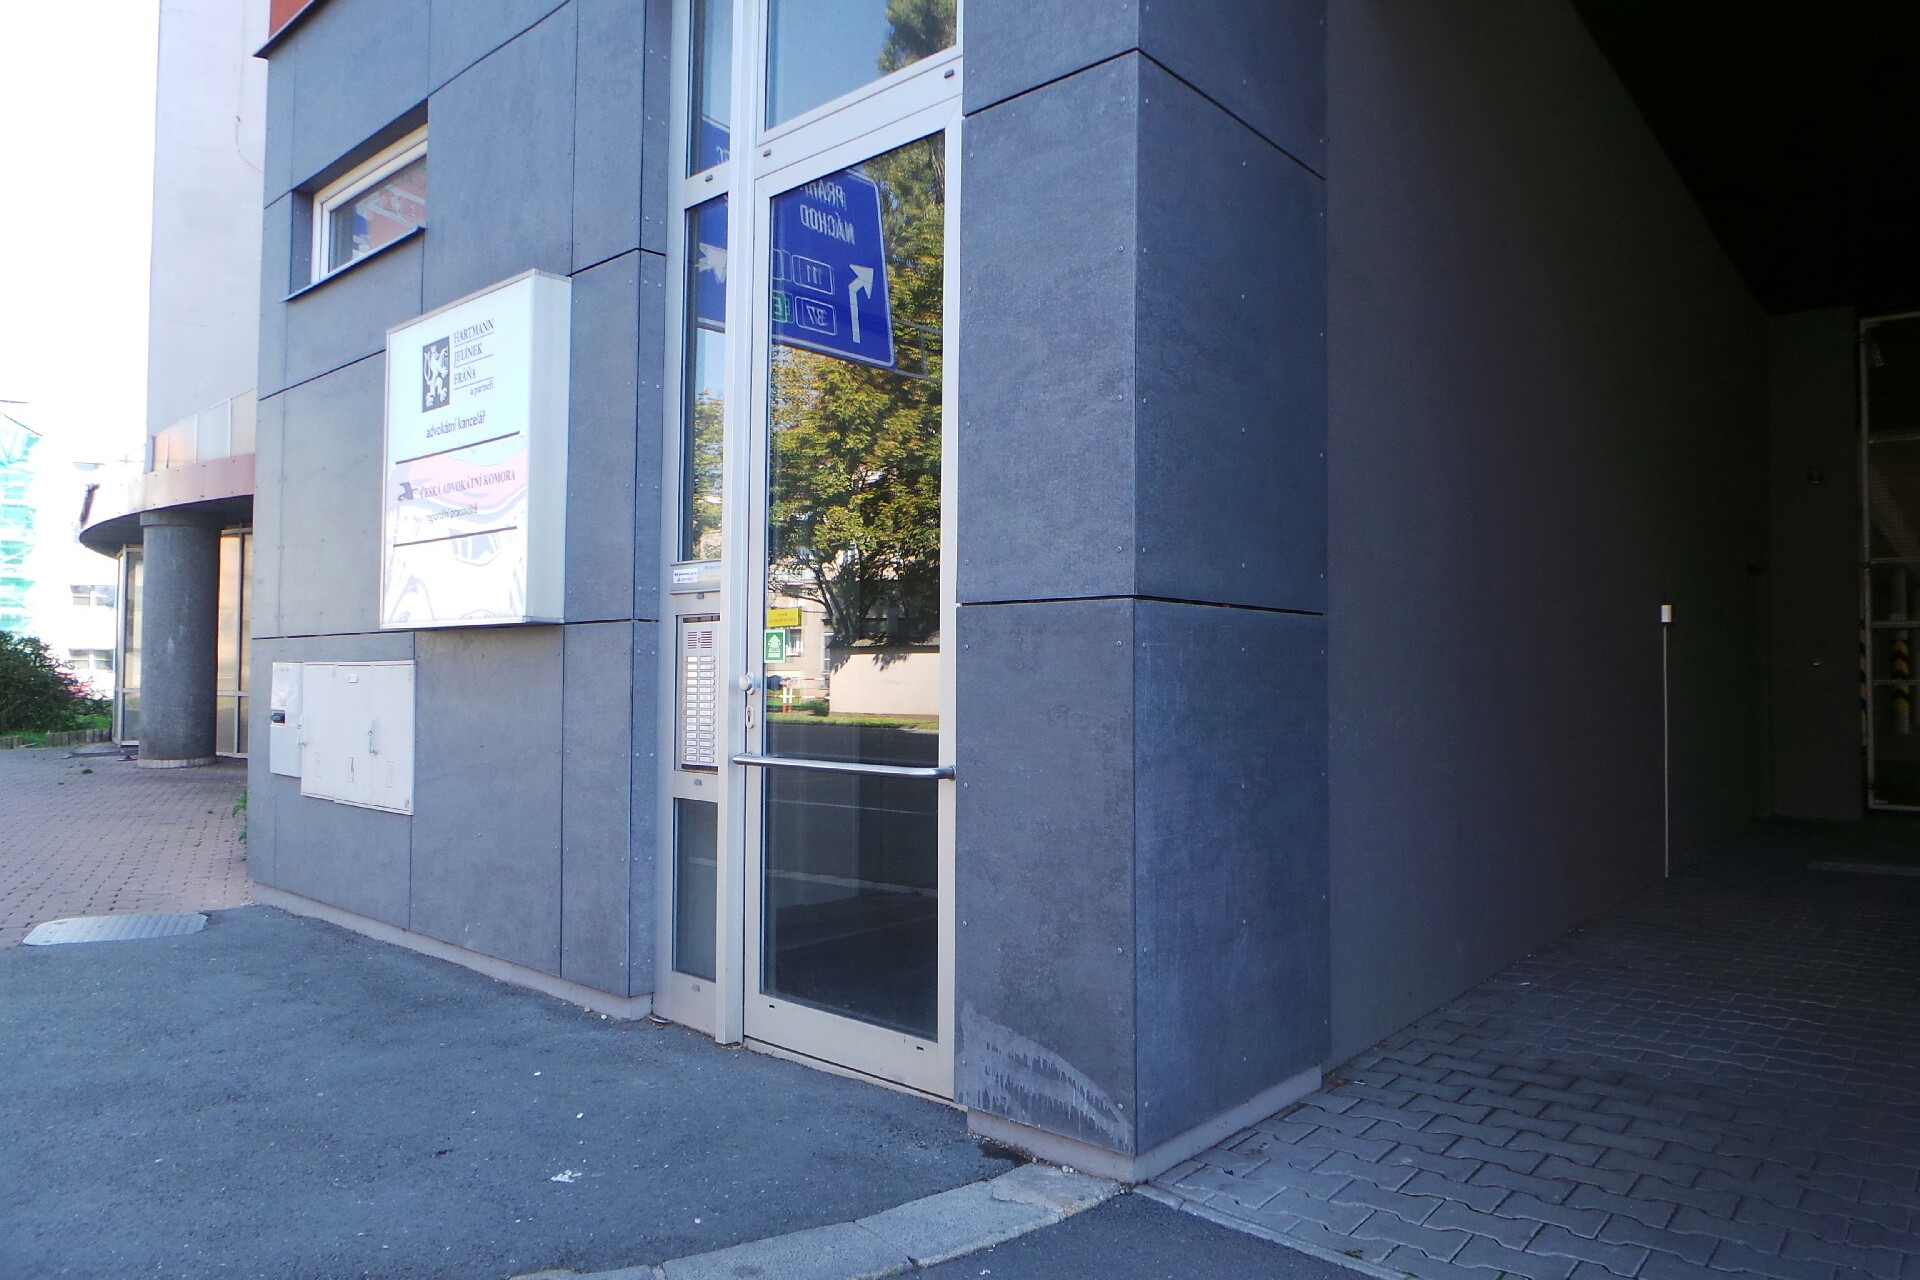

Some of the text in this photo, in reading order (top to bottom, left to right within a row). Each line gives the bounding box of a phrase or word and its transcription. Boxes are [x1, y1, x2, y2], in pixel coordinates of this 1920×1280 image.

[454, 318, 494, 343] HARTMANN
[454, 343, 483, 367] JELÍNEK
[454, 366, 476, 385] FRÁŇA
[426, 410, 486, 438] advokátní kancelář
[420, 469, 516, 498] ČESKÁ ADVOKÁTNÍ KOMORA
